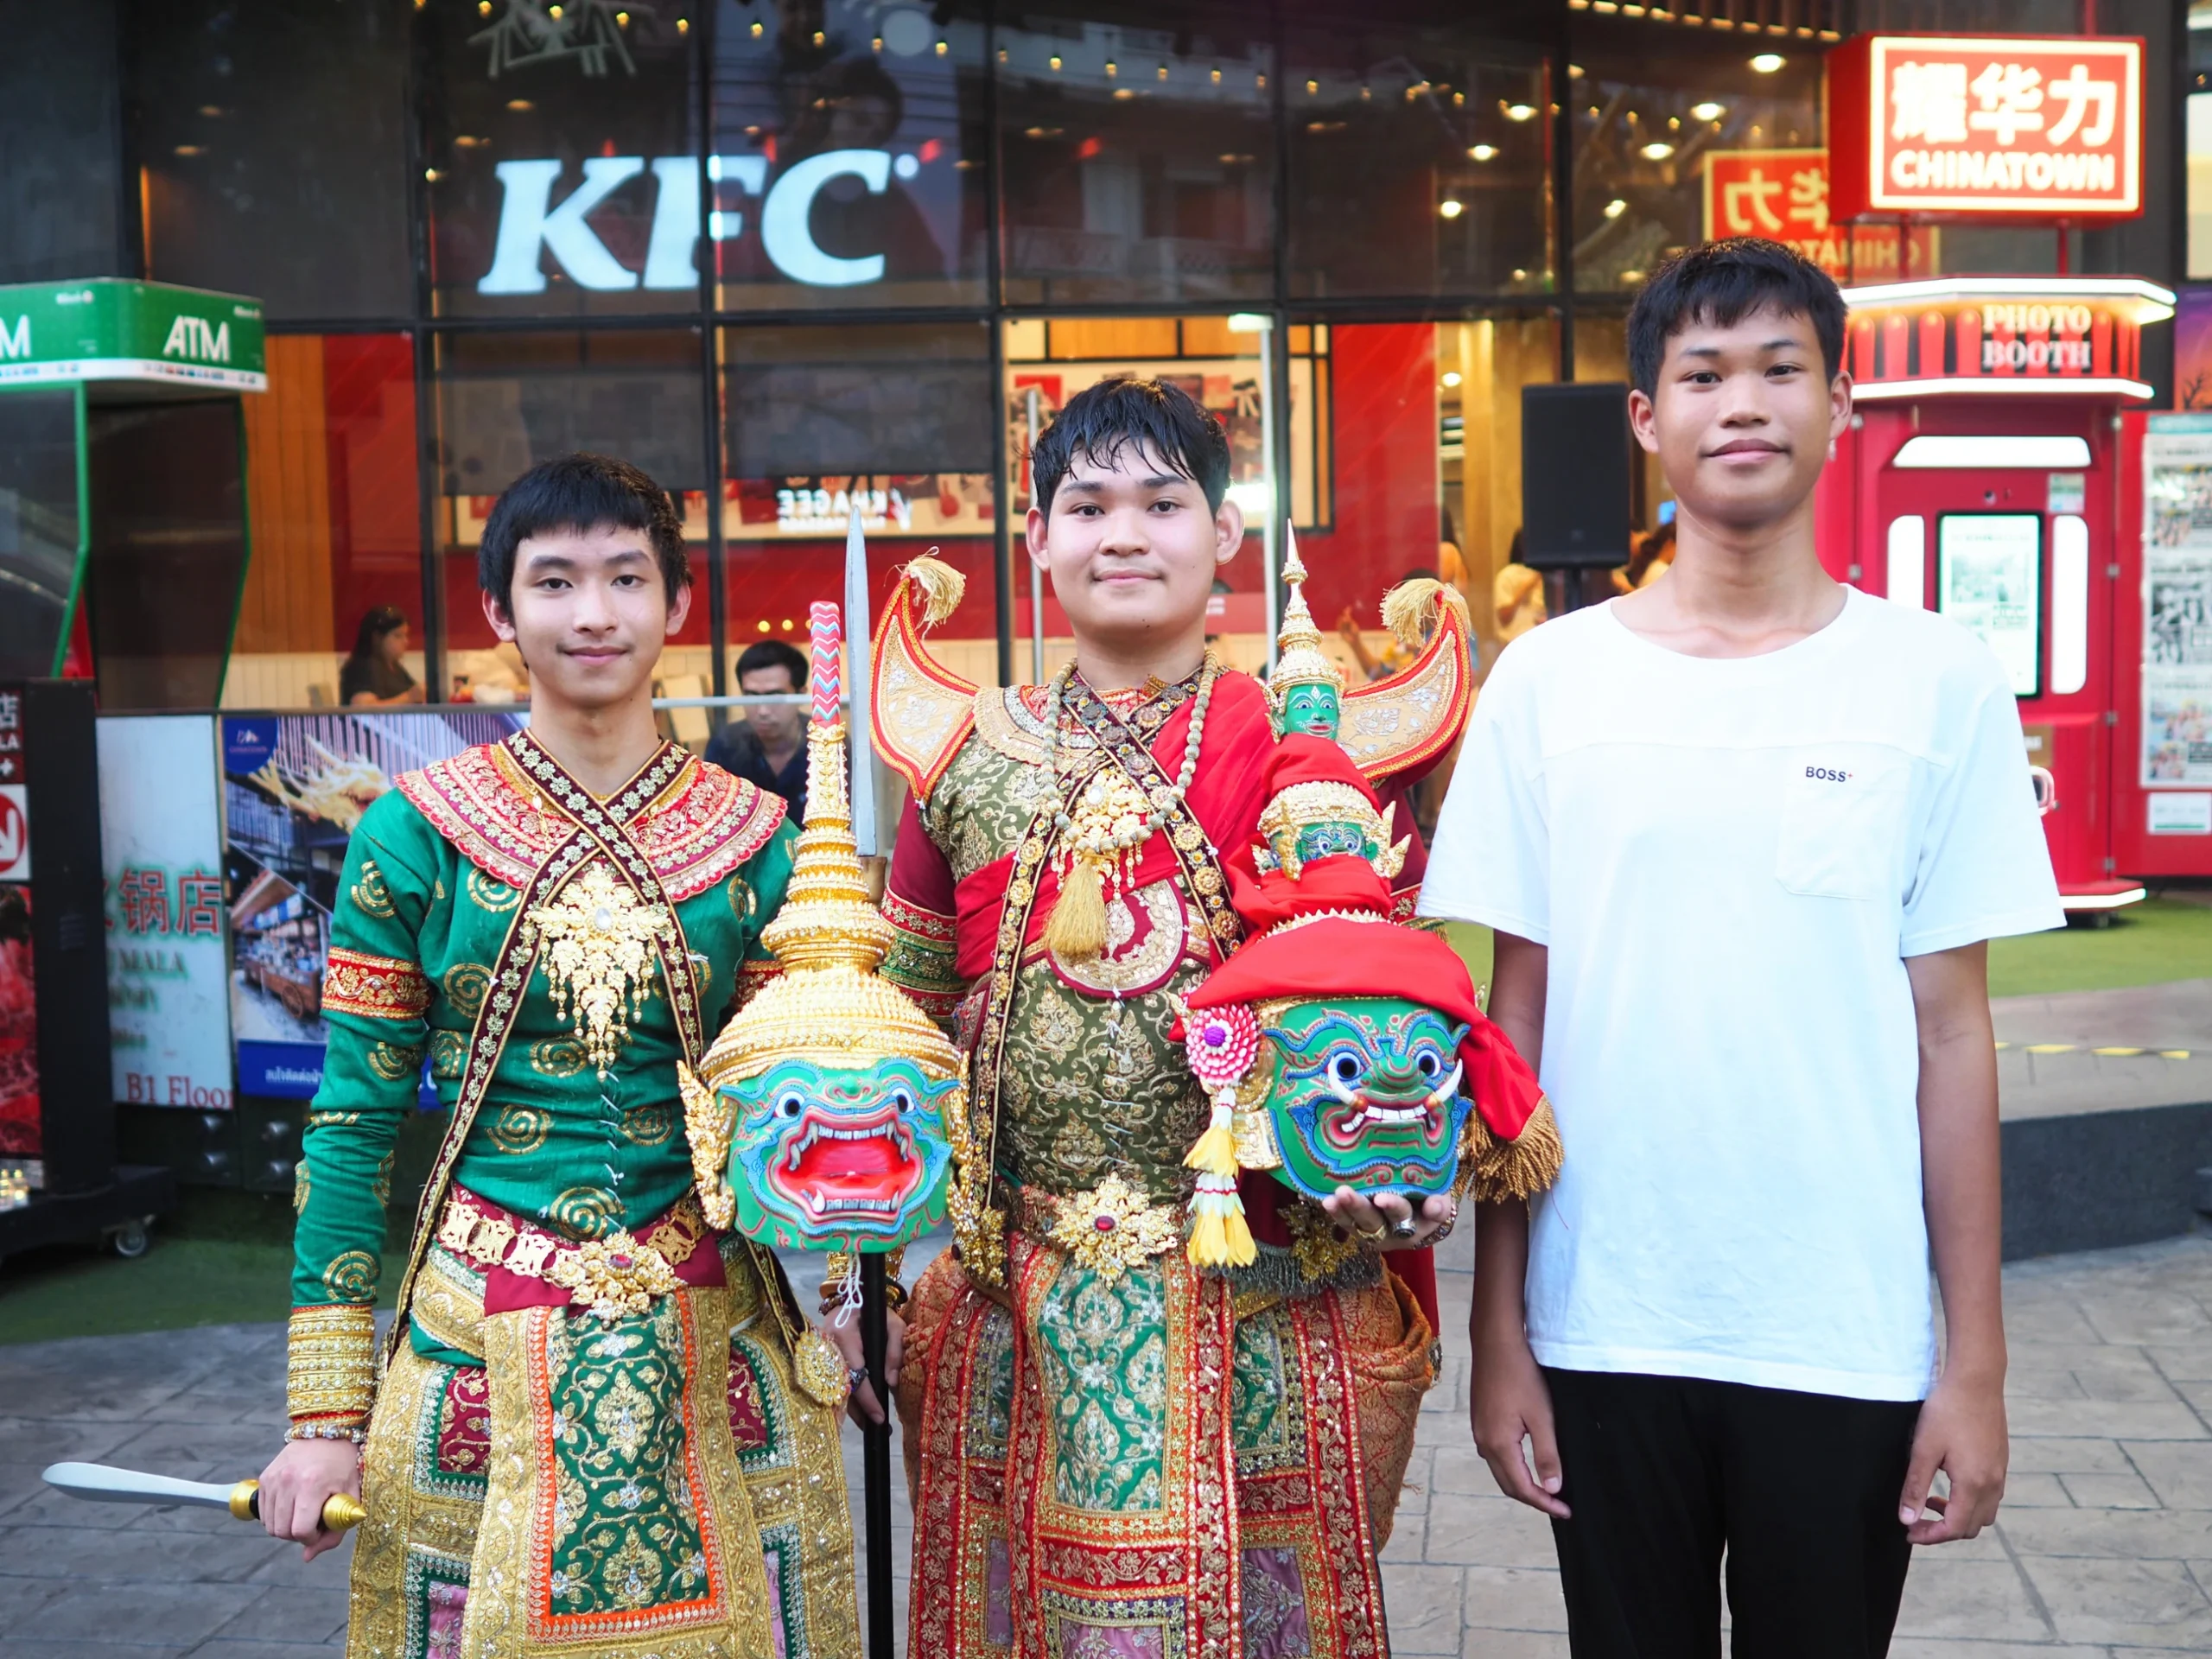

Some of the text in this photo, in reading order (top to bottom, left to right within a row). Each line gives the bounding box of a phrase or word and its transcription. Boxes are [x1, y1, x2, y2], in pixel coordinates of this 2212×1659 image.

[1891, 149, 2115, 192] CHINATOWN
[478, 149, 891, 296] KFC
[1981, 304, 2092, 334] PHOTO
[162, 315, 230, 363] ATM
[1981, 340, 2092, 369] BOOTH
[1805, 766, 1847, 783] BOSS
[119, 949, 184, 973] MALA
[126, 1072, 156, 1103] B1
